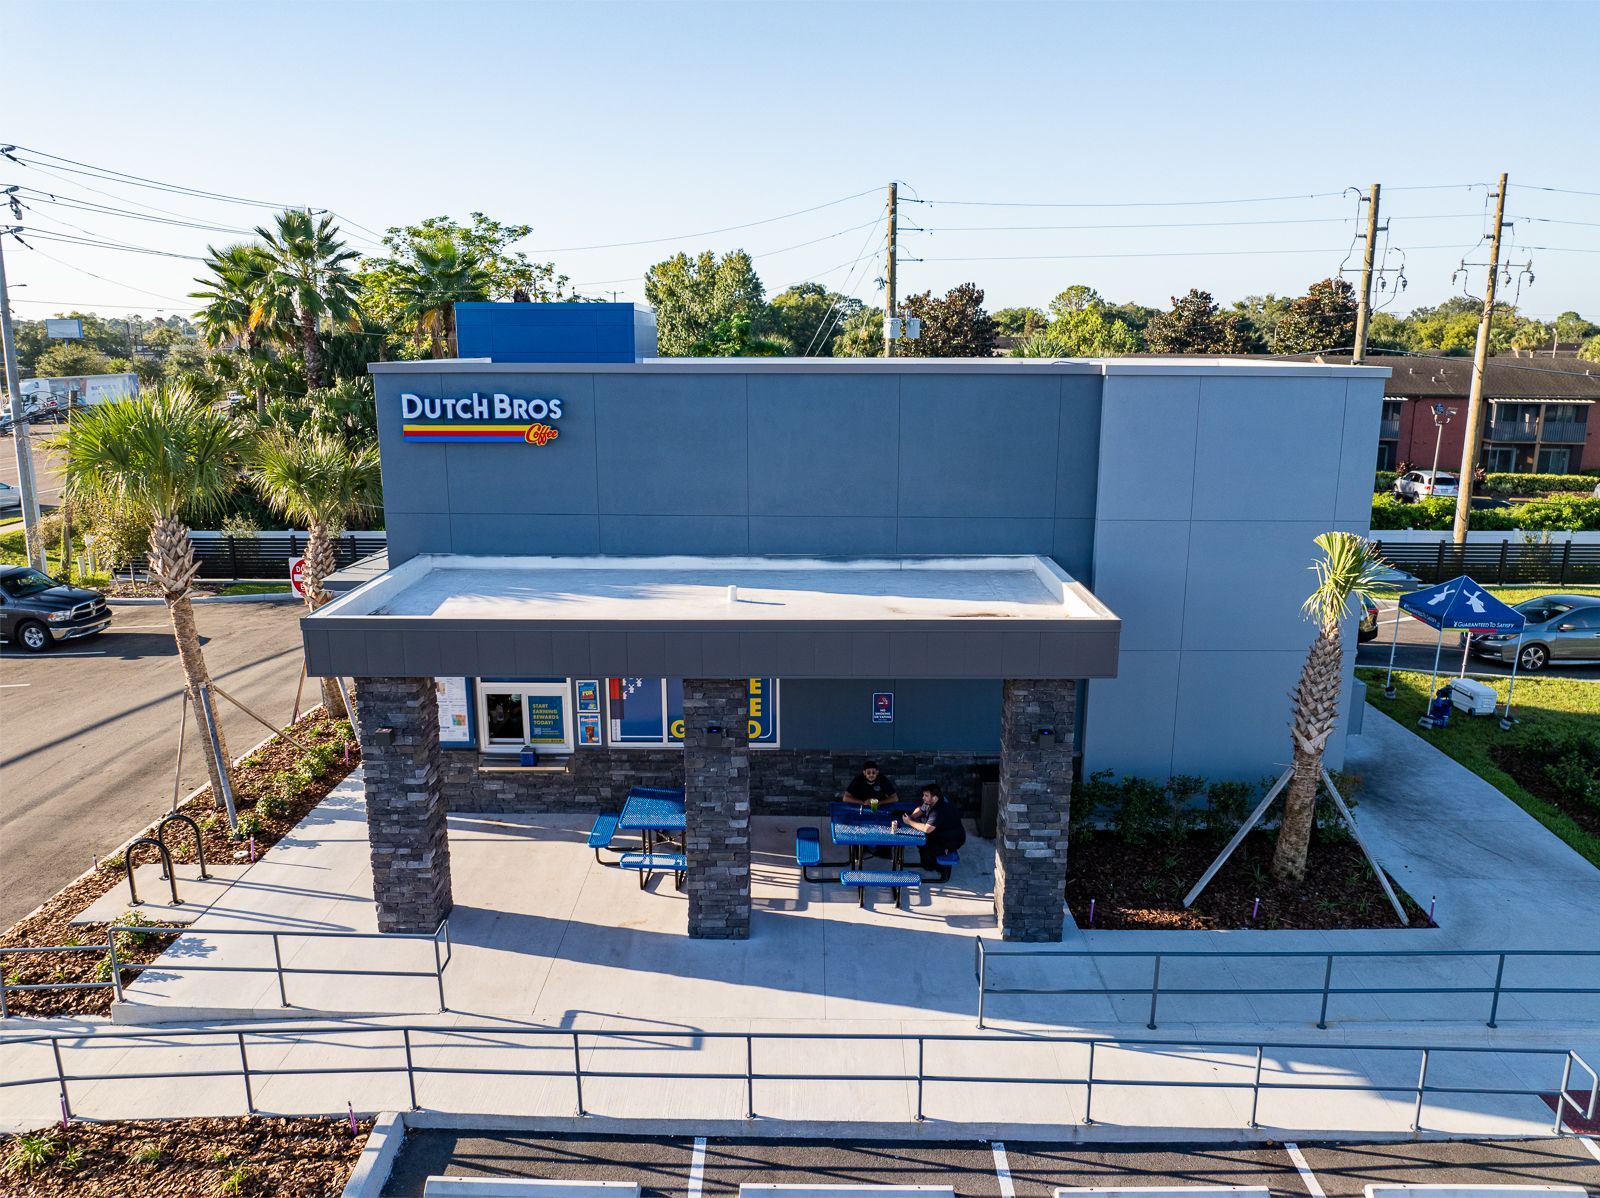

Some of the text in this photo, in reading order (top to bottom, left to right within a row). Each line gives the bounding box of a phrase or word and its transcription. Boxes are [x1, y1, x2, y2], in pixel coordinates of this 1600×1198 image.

[401, 392, 562, 420] DUTCH BROS
[525, 422, 559, 446] Coffee
